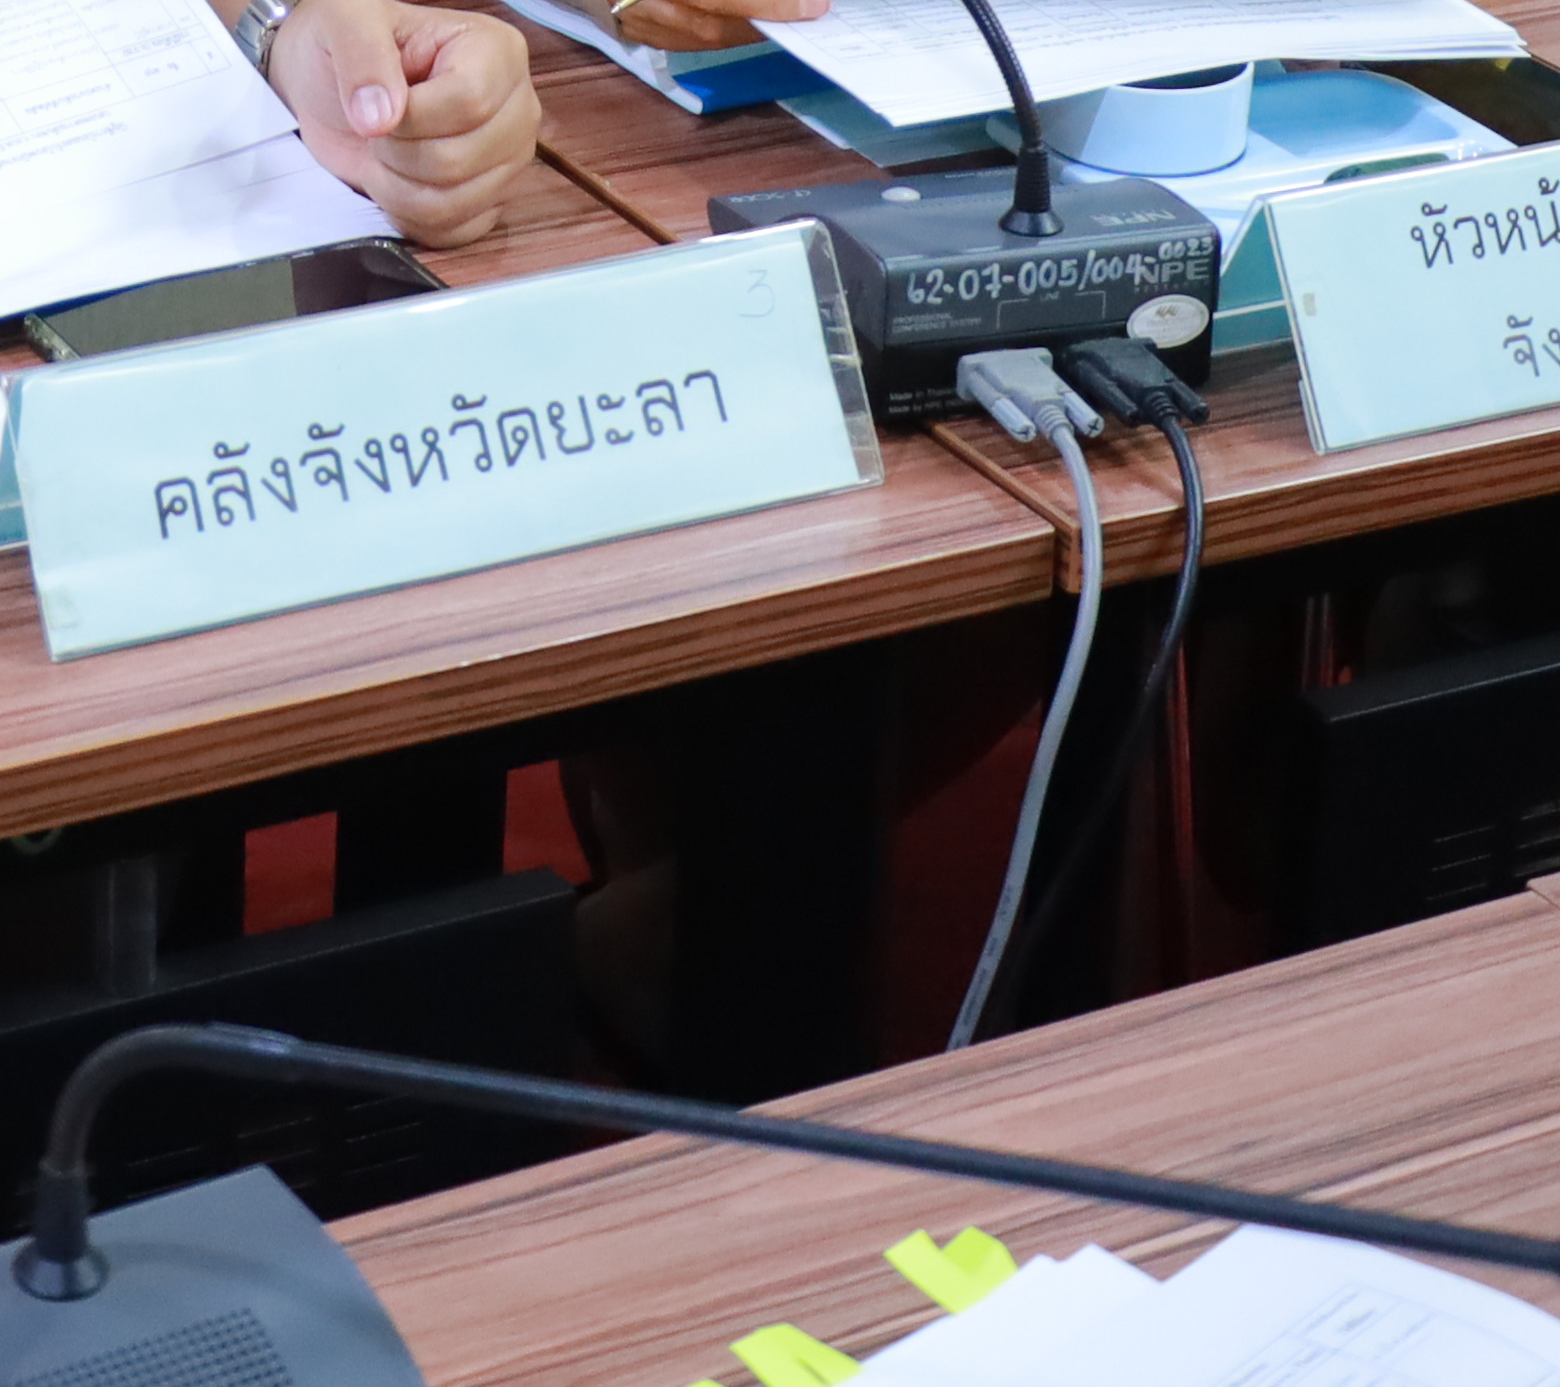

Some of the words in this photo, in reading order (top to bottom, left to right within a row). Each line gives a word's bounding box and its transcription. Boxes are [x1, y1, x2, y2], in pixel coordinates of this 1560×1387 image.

[154, 368, 728, 539] คลังจังหวัดยะลา
